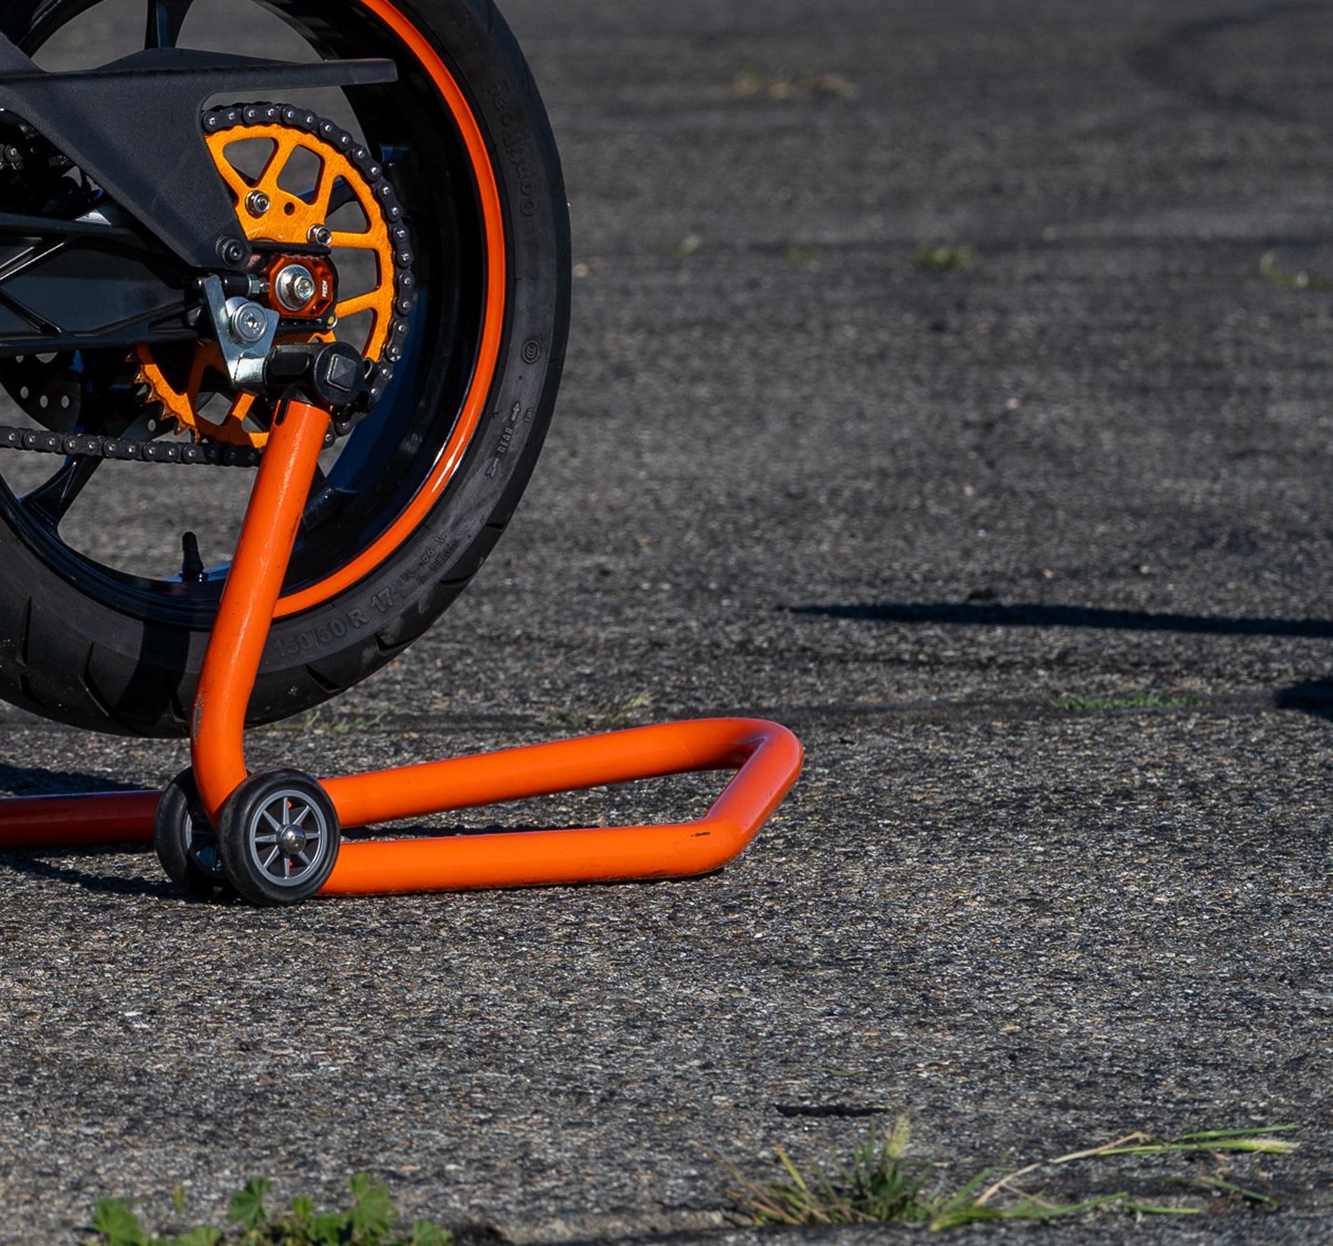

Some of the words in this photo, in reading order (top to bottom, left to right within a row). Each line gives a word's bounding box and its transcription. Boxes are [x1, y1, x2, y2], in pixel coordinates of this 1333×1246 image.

[496, 426, 514, 454] REAR
[347, 607, 371, 628] R
[370, 586, 394, 612] 17
